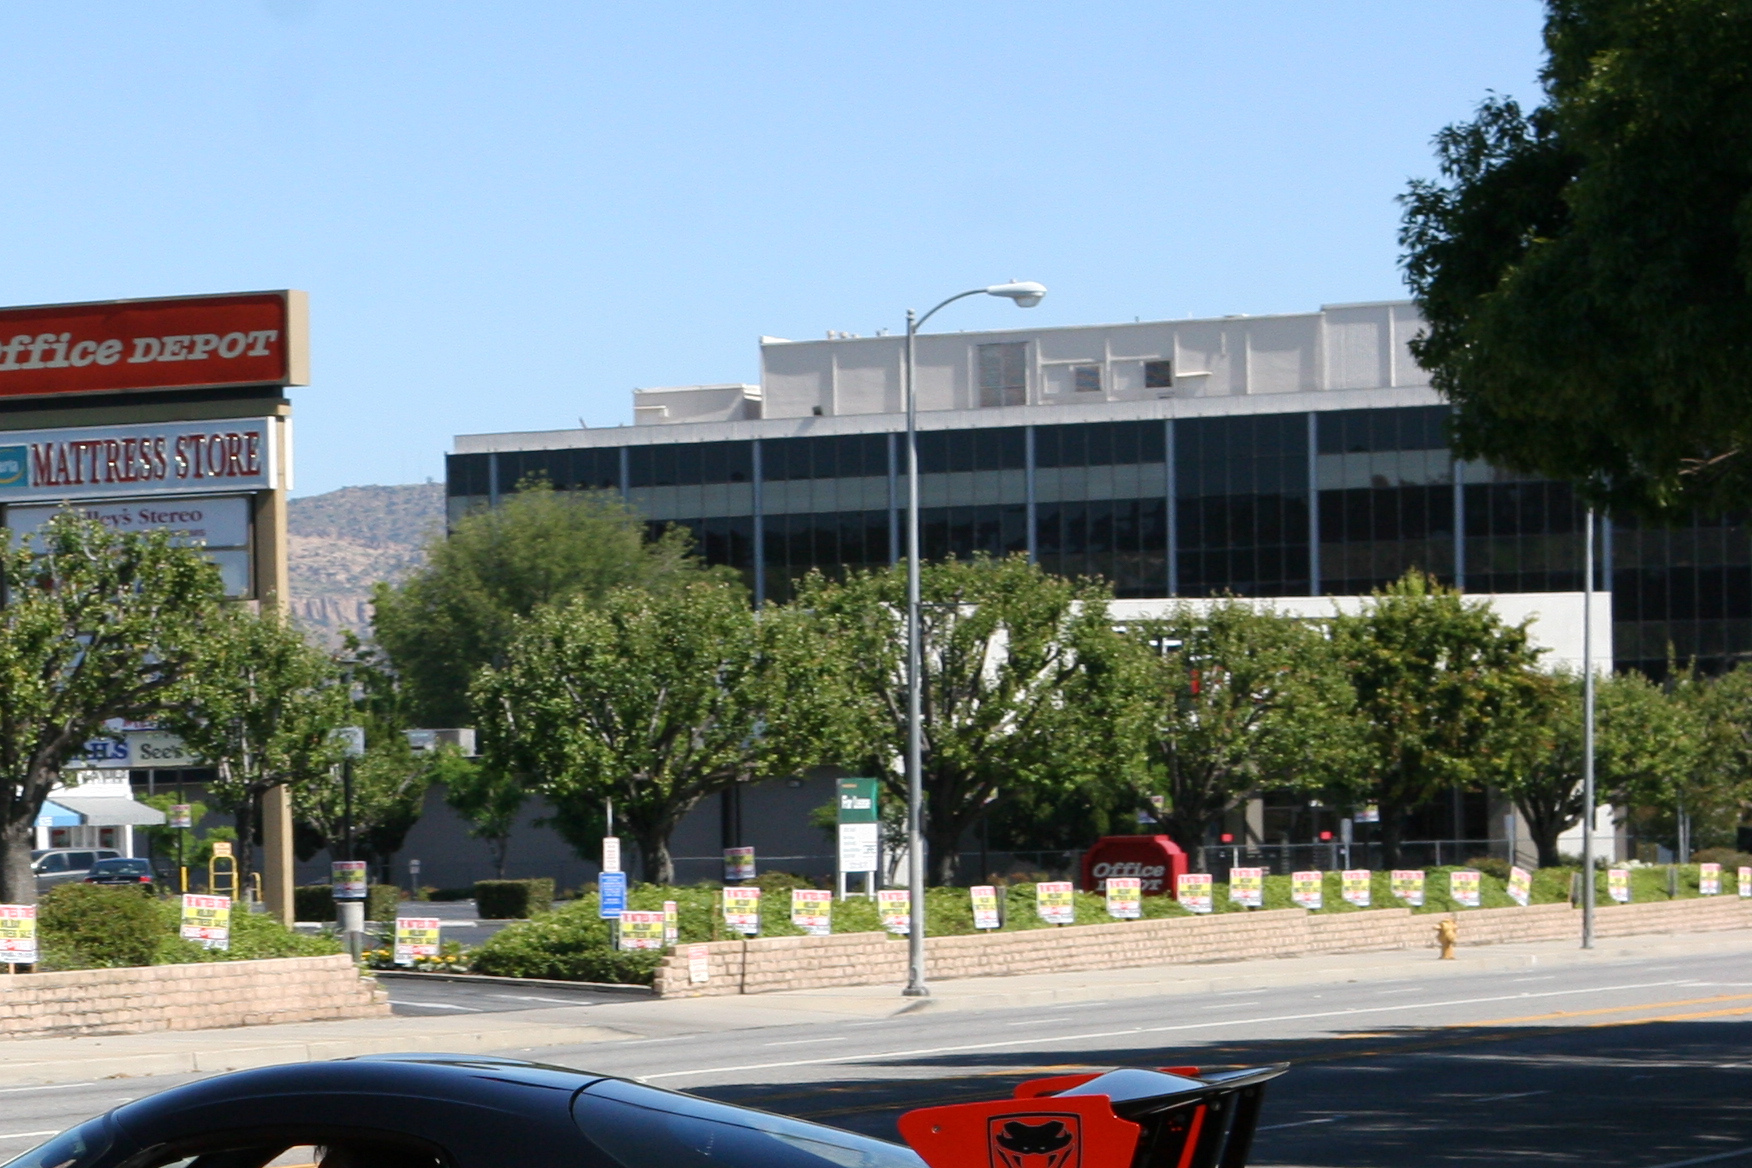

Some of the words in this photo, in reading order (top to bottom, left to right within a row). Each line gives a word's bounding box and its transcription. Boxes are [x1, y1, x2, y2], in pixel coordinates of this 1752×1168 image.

[126, 330, 278, 364] DEPOT
[31, 437, 166, 487] MATTRESS
[175, 432, 261, 479] STORE
[138, 508, 203, 524] Stereo
[140, 744, 183, 760] See's
[1092, 862, 1165, 878] Office
